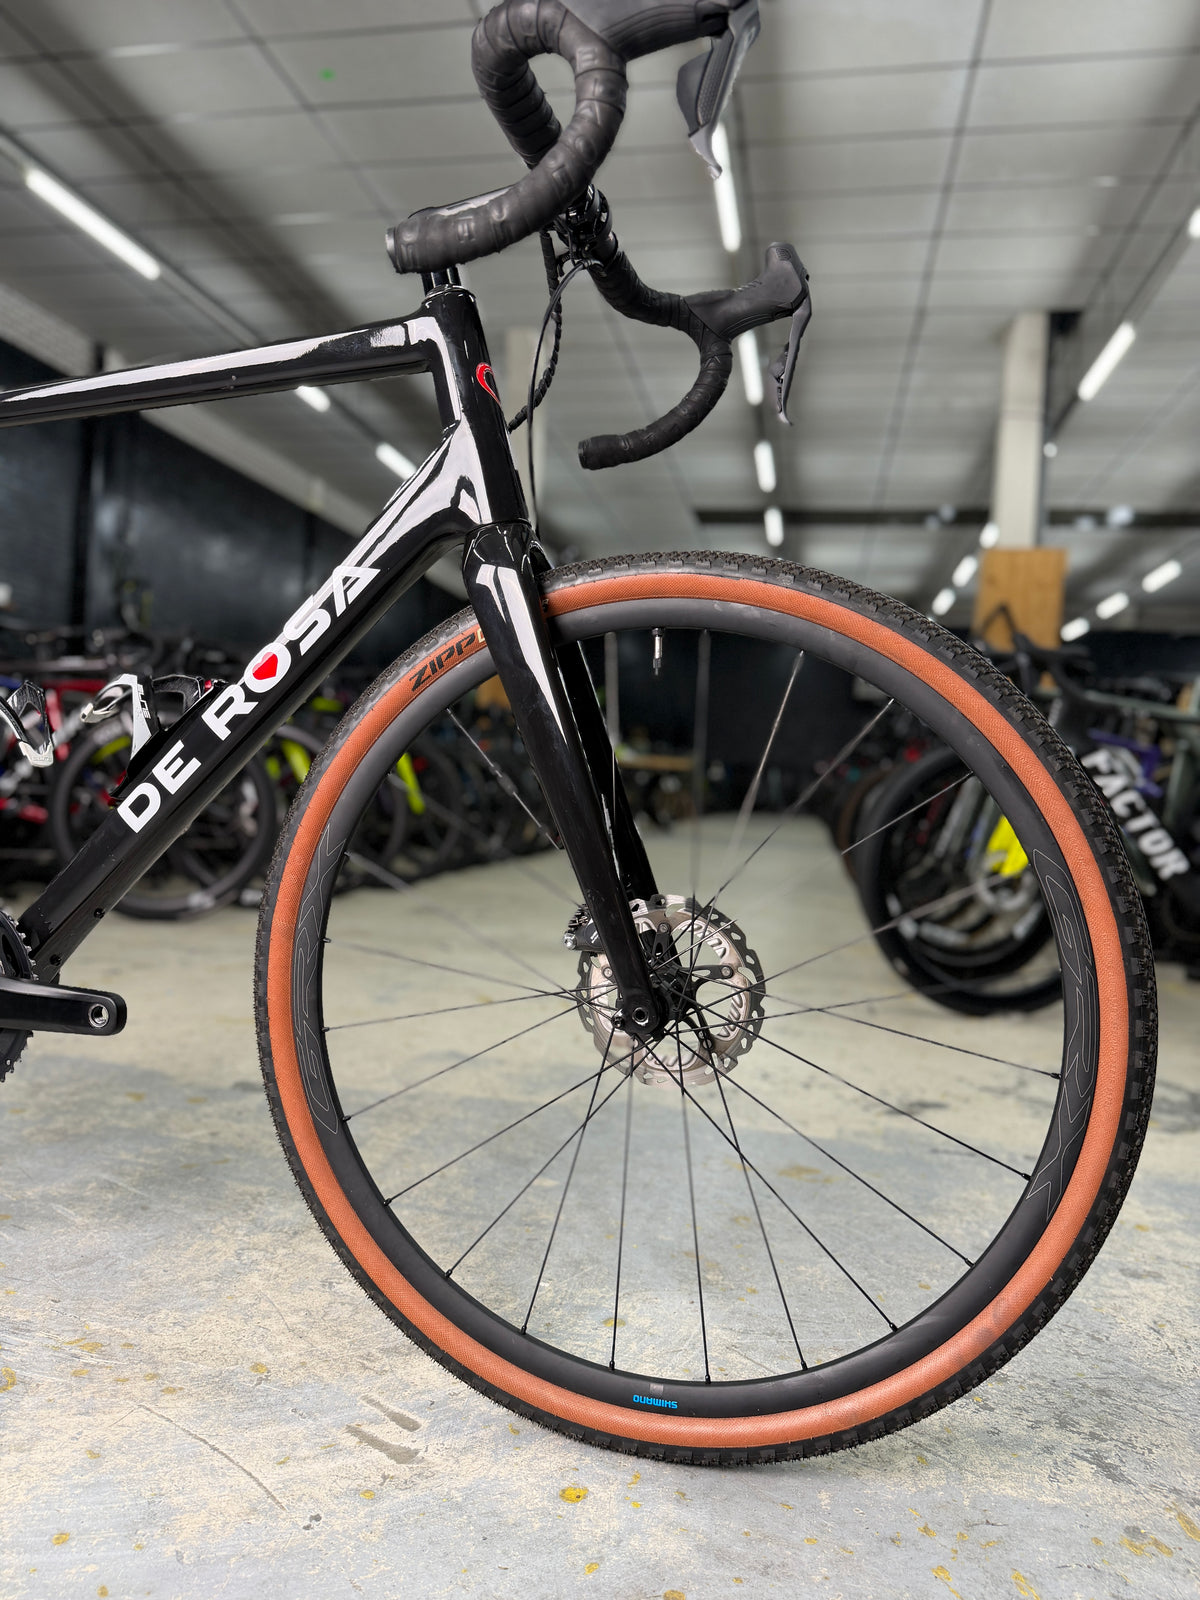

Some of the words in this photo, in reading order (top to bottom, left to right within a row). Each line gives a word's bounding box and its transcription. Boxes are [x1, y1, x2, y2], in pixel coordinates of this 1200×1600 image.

[117, 740, 201, 833] DE
[201, 565, 380, 741] ROSA
[409, 632, 475, 692] ZIPP
[1080, 746, 1190, 881] FACTOR
[632, 1394, 678, 1409] SHIMANO
